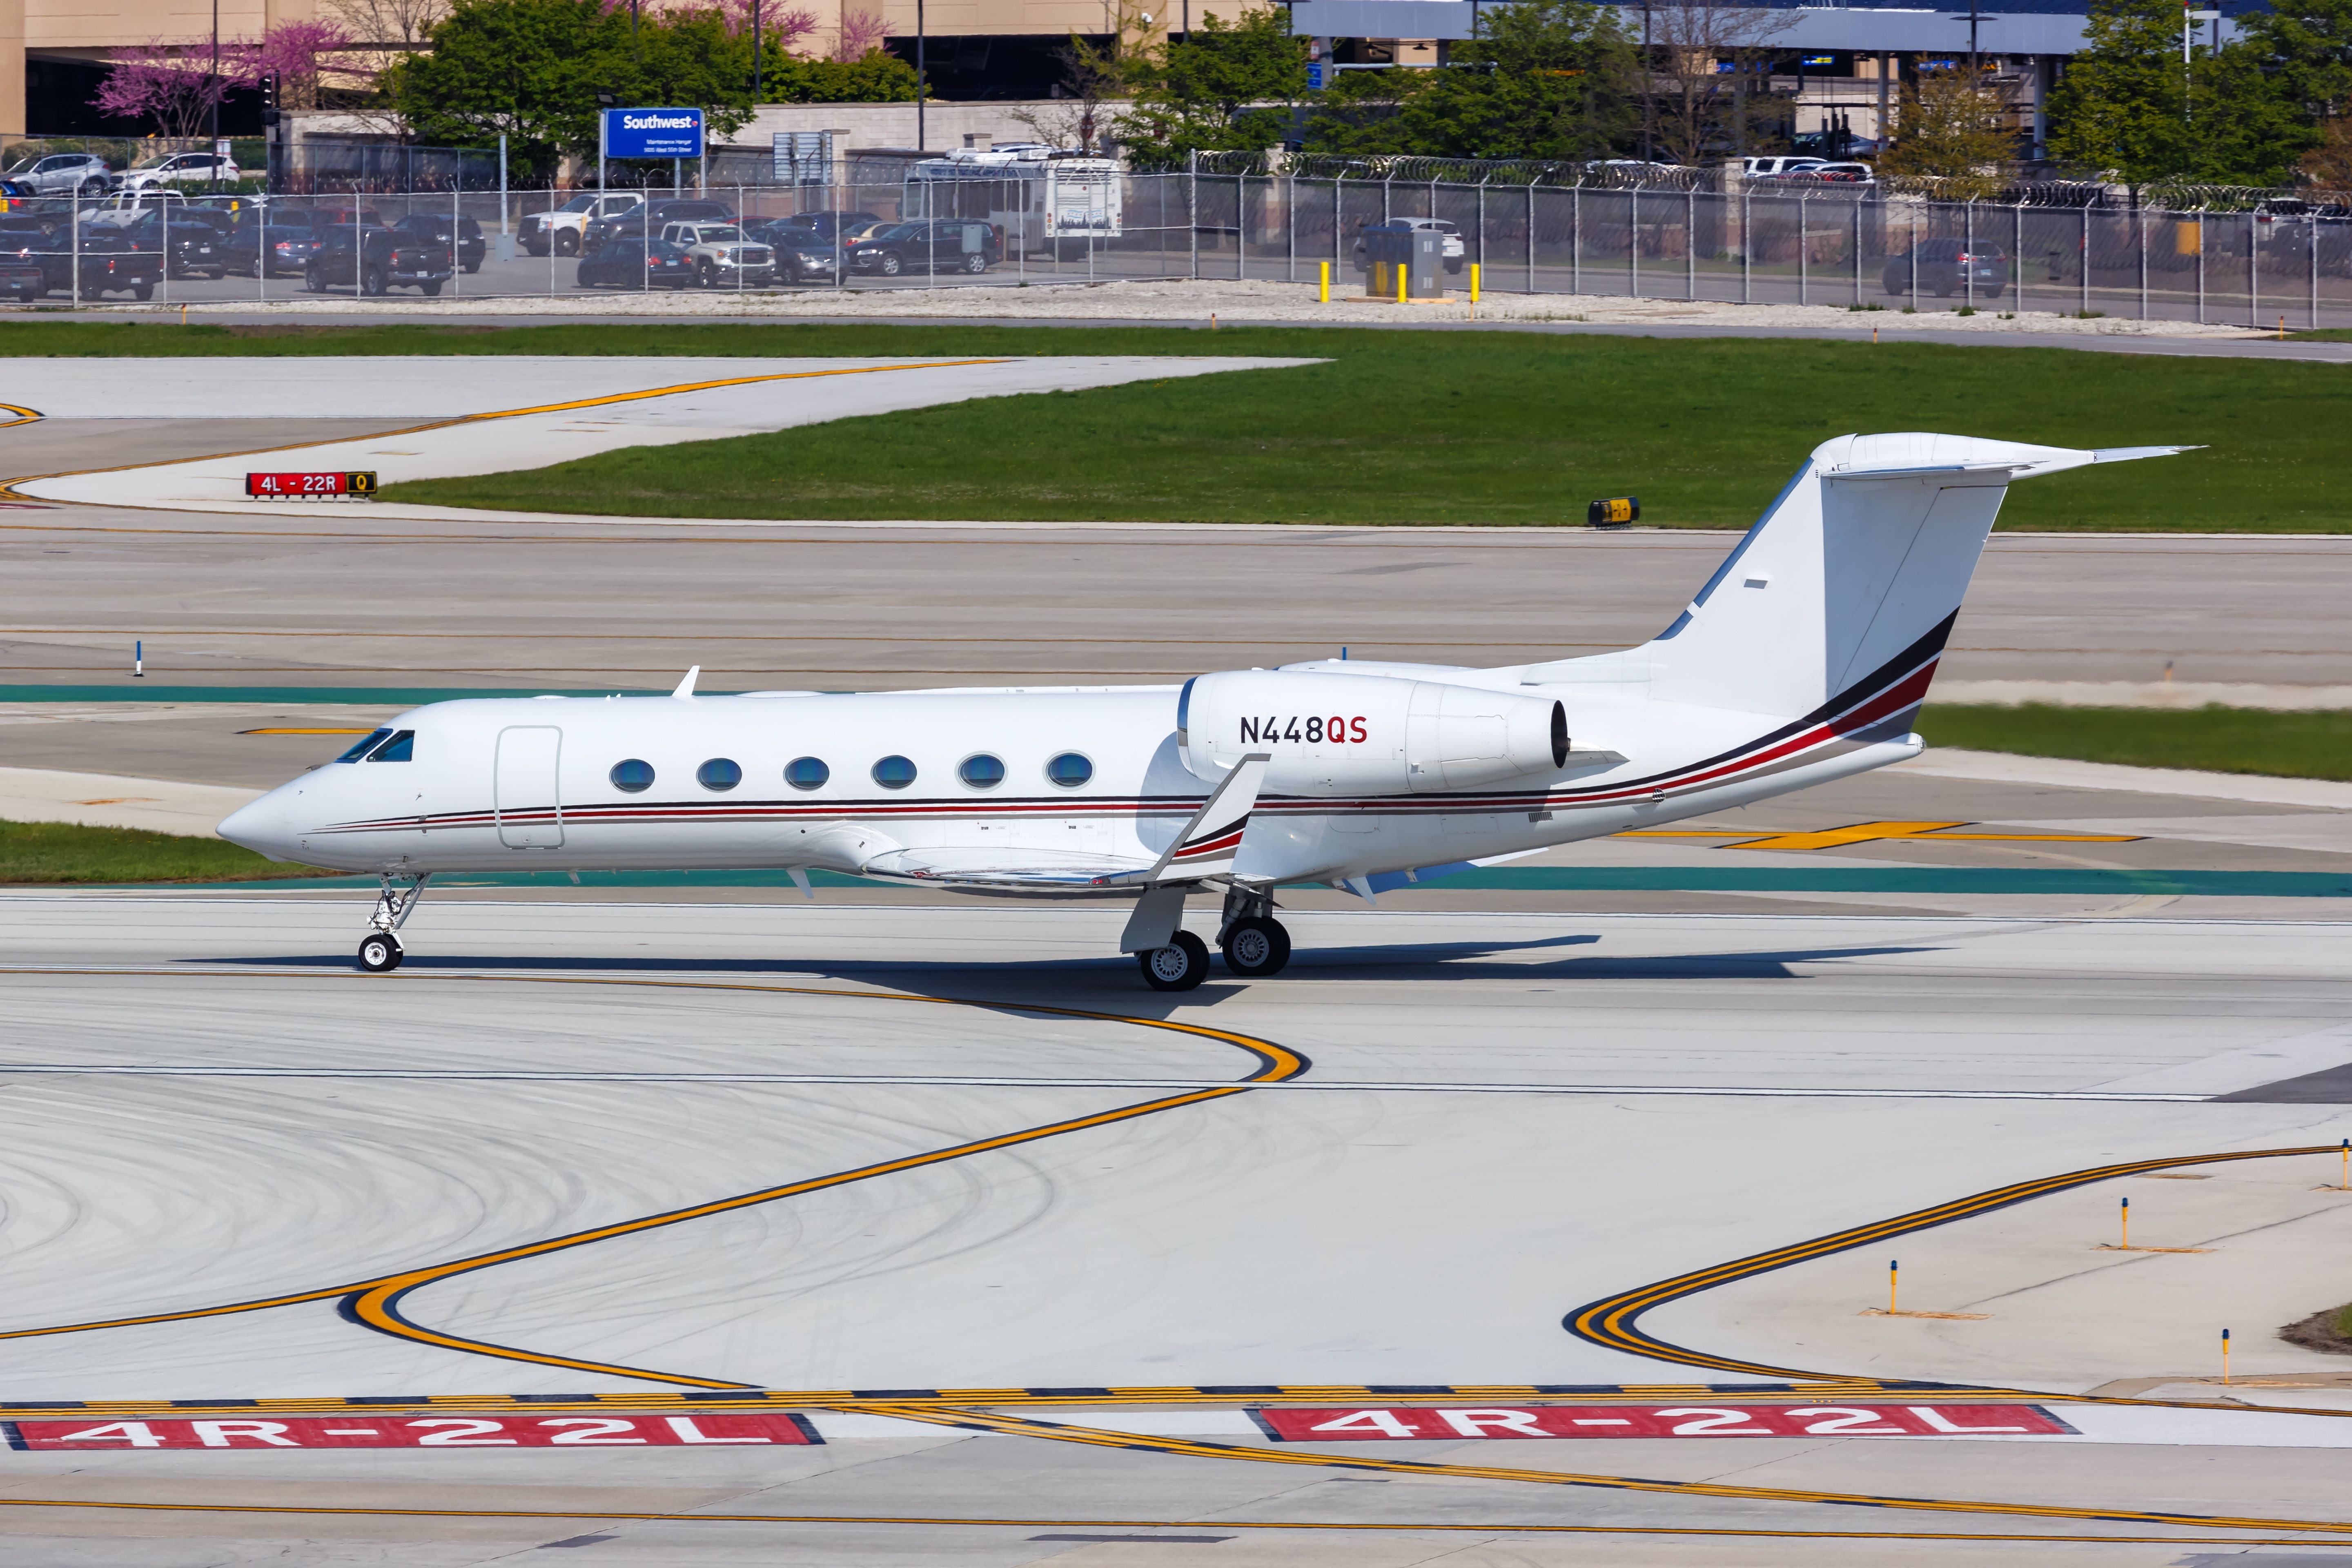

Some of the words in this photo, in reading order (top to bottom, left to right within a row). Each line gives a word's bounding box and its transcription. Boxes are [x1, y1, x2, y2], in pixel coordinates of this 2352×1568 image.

[624, 114, 692, 129] Southwest
[356, 475, 367, 490] Q
[1241, 716, 1367, 744] N448QS
[60, 1419, 772, 1447] 4R-22L
[1310, 1407, 2029, 1437] 4R-22L
